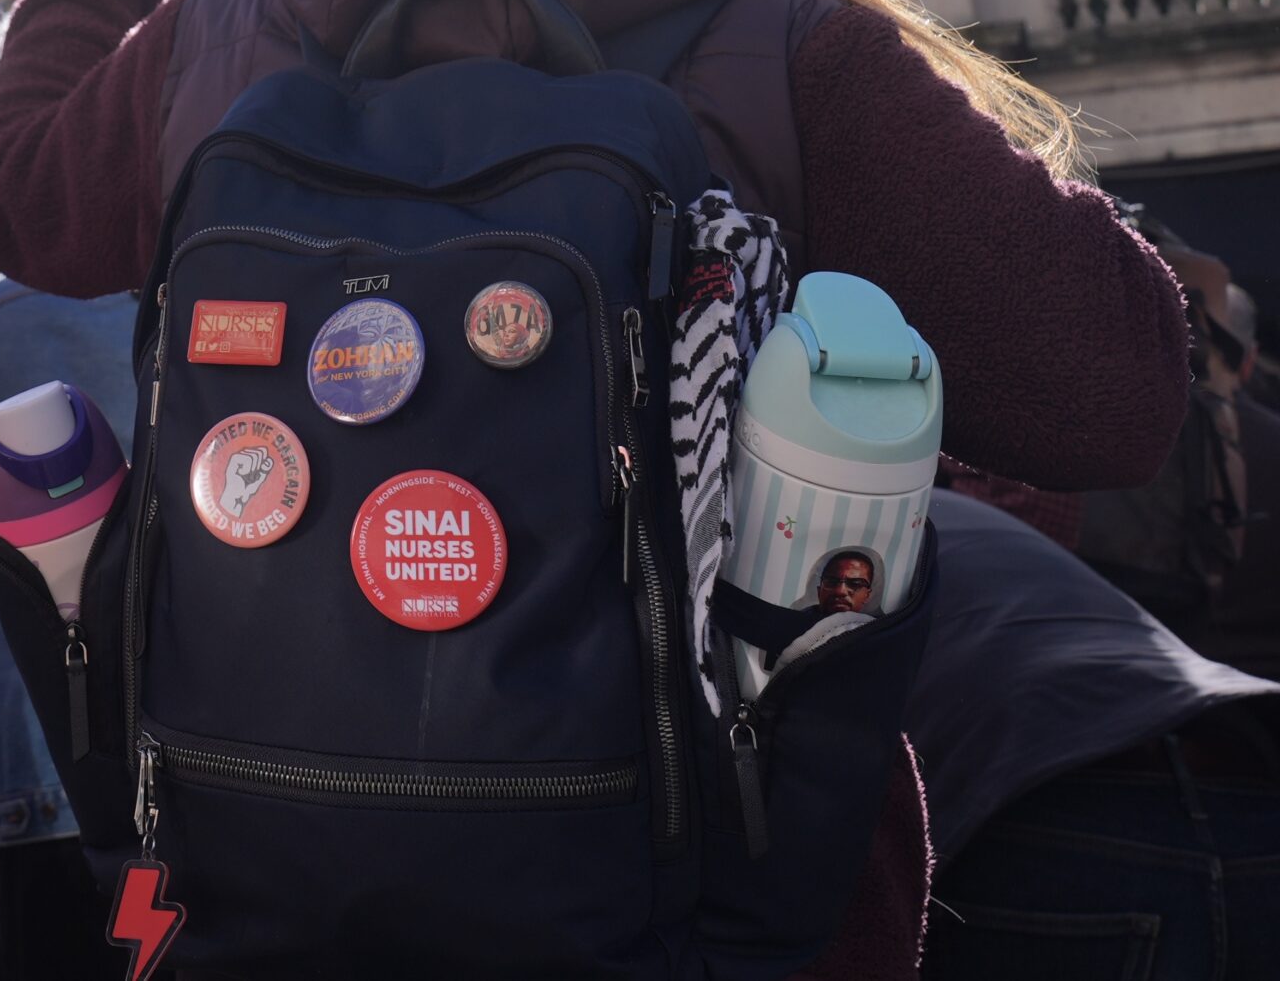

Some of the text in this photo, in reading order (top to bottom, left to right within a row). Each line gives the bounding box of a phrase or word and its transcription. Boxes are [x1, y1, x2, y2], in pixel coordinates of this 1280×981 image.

[198, 315, 275, 332] NURSES
[314, 340, 414, 372] ZOHRAN
[331, 371, 354, 382] NEW
[355, 367, 381, 380] YORK
[384, 365, 409, 377] CITY
[252, 421, 273, 440] WE
[272, 433, 300, 509] BARGAIN
[375, 477, 435, 506] MORNINGSIDE
[448, 481, 471, 497] WEST
[231, 520, 255, 539] WE
[257, 508, 287, 536] BEG
[385, 509, 470, 536] SINAI
[477, 502, 497, 532] SOUTH
[358, 516, 373, 559] HOSPITAL
[385, 540, 475, 558] NURSES
[492, 533, 503, 571] NASSAU
[360, 560, 375, 586] SINAI
[385, 562, 478, 582] UNITED!
[477, 581, 496, 603] NYEE
[401, 599, 460, 612] NURSES
